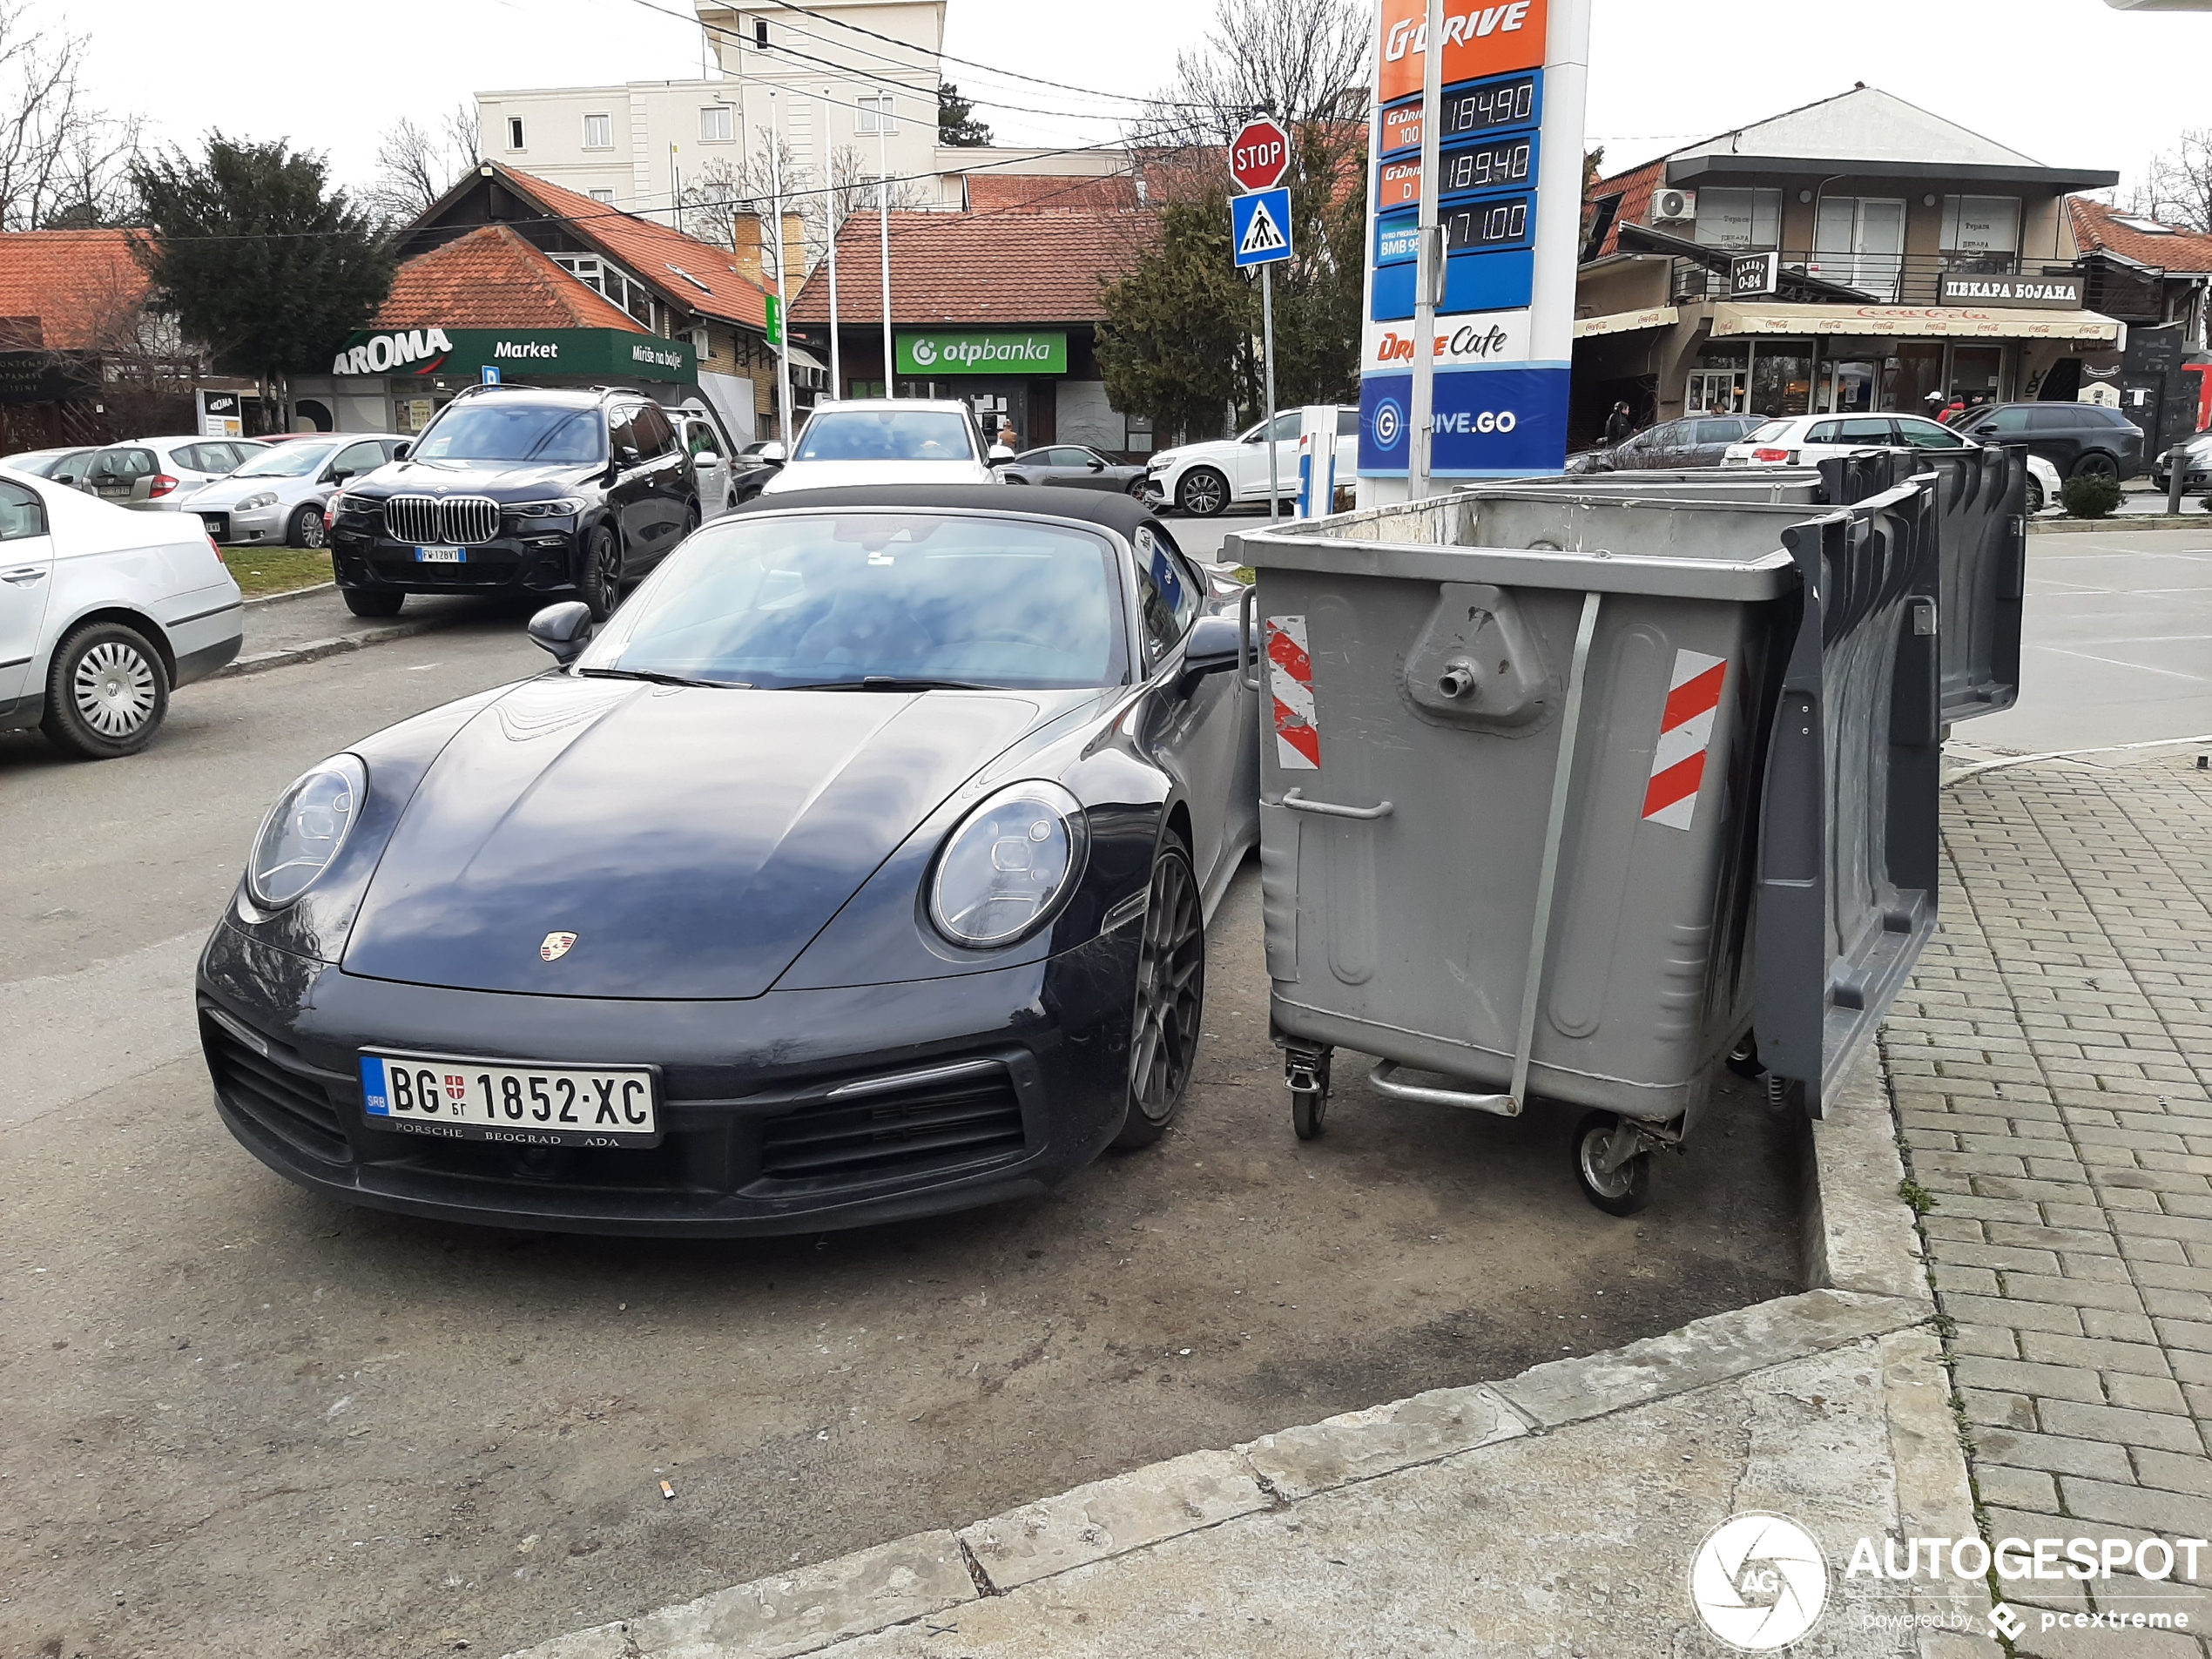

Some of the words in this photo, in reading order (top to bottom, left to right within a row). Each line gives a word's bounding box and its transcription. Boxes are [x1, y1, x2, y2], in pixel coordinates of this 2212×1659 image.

[1400, 125, 1420, 144] 100
[1237, 141, 1281, 171] STOP
[1449, 145, 1530, 188] 189.40
[1403, 183, 1412, 199] D
[1381, 239, 1407, 257] BMB
[1737, 260, 1765, 277] BAKERY
[1738, 273, 1761, 289] 0-24
[1946, 281, 2012, 298] ПЕКАРА
[2015, 283, 2077, 300] БОЈАНА
[333, 327, 453, 374] AROMA
[494, 341, 558, 359] Market
[943, 338, 1050, 367] otpbanka
[1378, 333, 1449, 363] DRIE
[1450, 324, 1508, 358] Cafe
[655, 352, 664, 365] na
[390, 1065, 440, 1113] BG
[367, 1095, 386, 1108] SRB
[395, 1123, 464, 1139] PORSCHE
[485, 1132, 562, 1145] BEOGRAD
[585, 1137, 620, 1147] ADA
